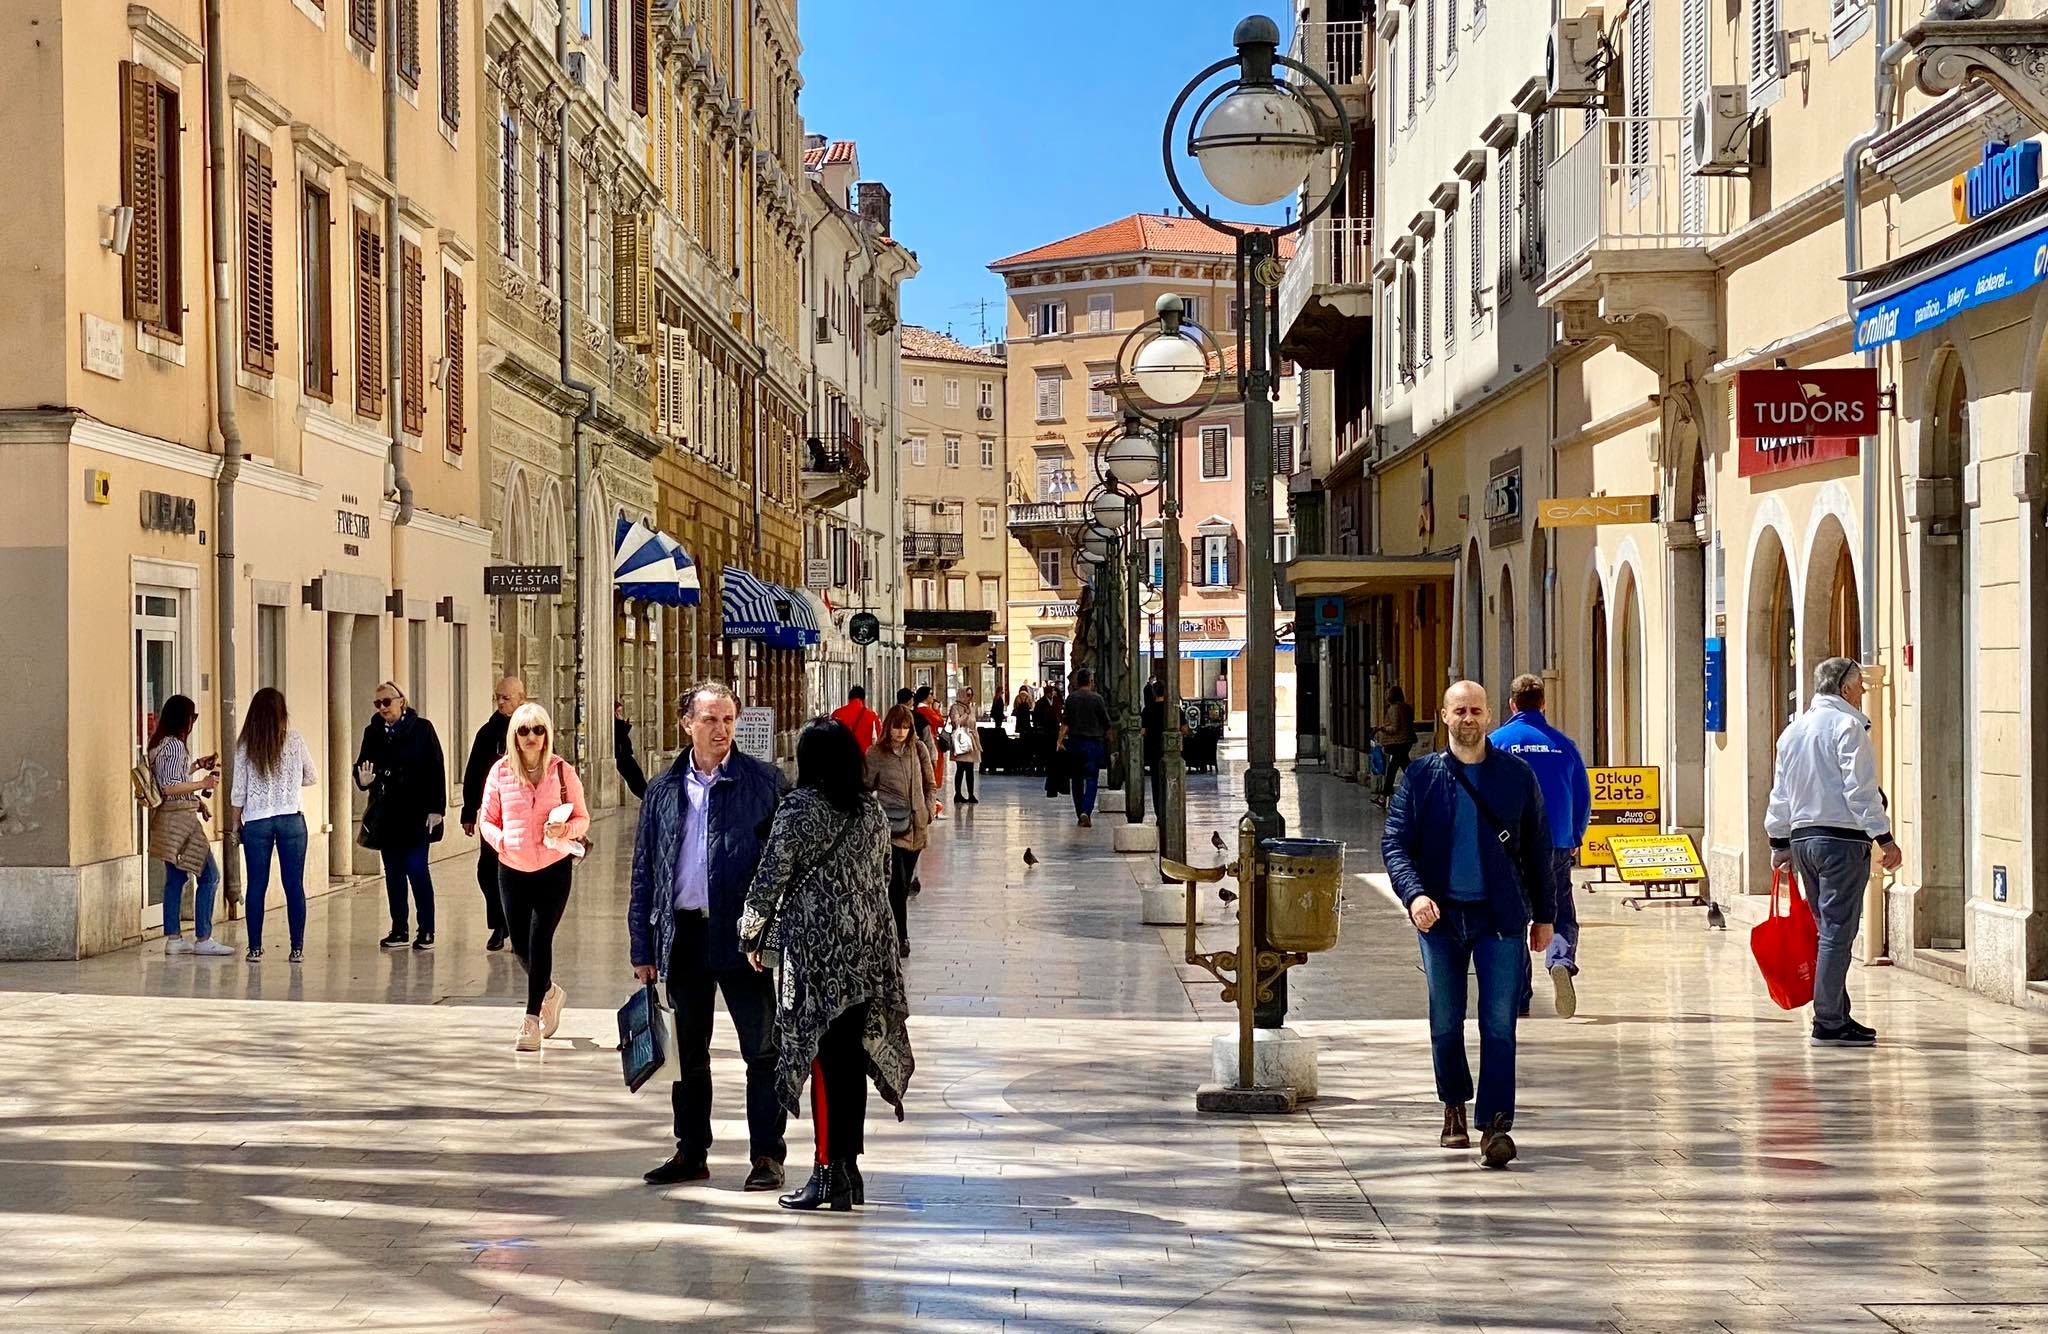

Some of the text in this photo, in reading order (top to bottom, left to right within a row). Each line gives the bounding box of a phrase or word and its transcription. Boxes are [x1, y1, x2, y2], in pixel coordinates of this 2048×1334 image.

[1966, 140, 2026, 219] mlinar
[1866, 305, 1900, 345] mlinar
[1754, 401, 1865, 423] TUDORS
[1547, 503, 1643, 519] GANT
[492, 575, 559, 585] FIVE STAR
[725, 626, 766, 634] MJENJAČNICA
[1595, 771, 1642, 786] Otkup
[1594, 785, 1644, 800] Zlata
[1616, 816, 1644, 824] Domus
[1625, 810, 1644, 818] Auro
